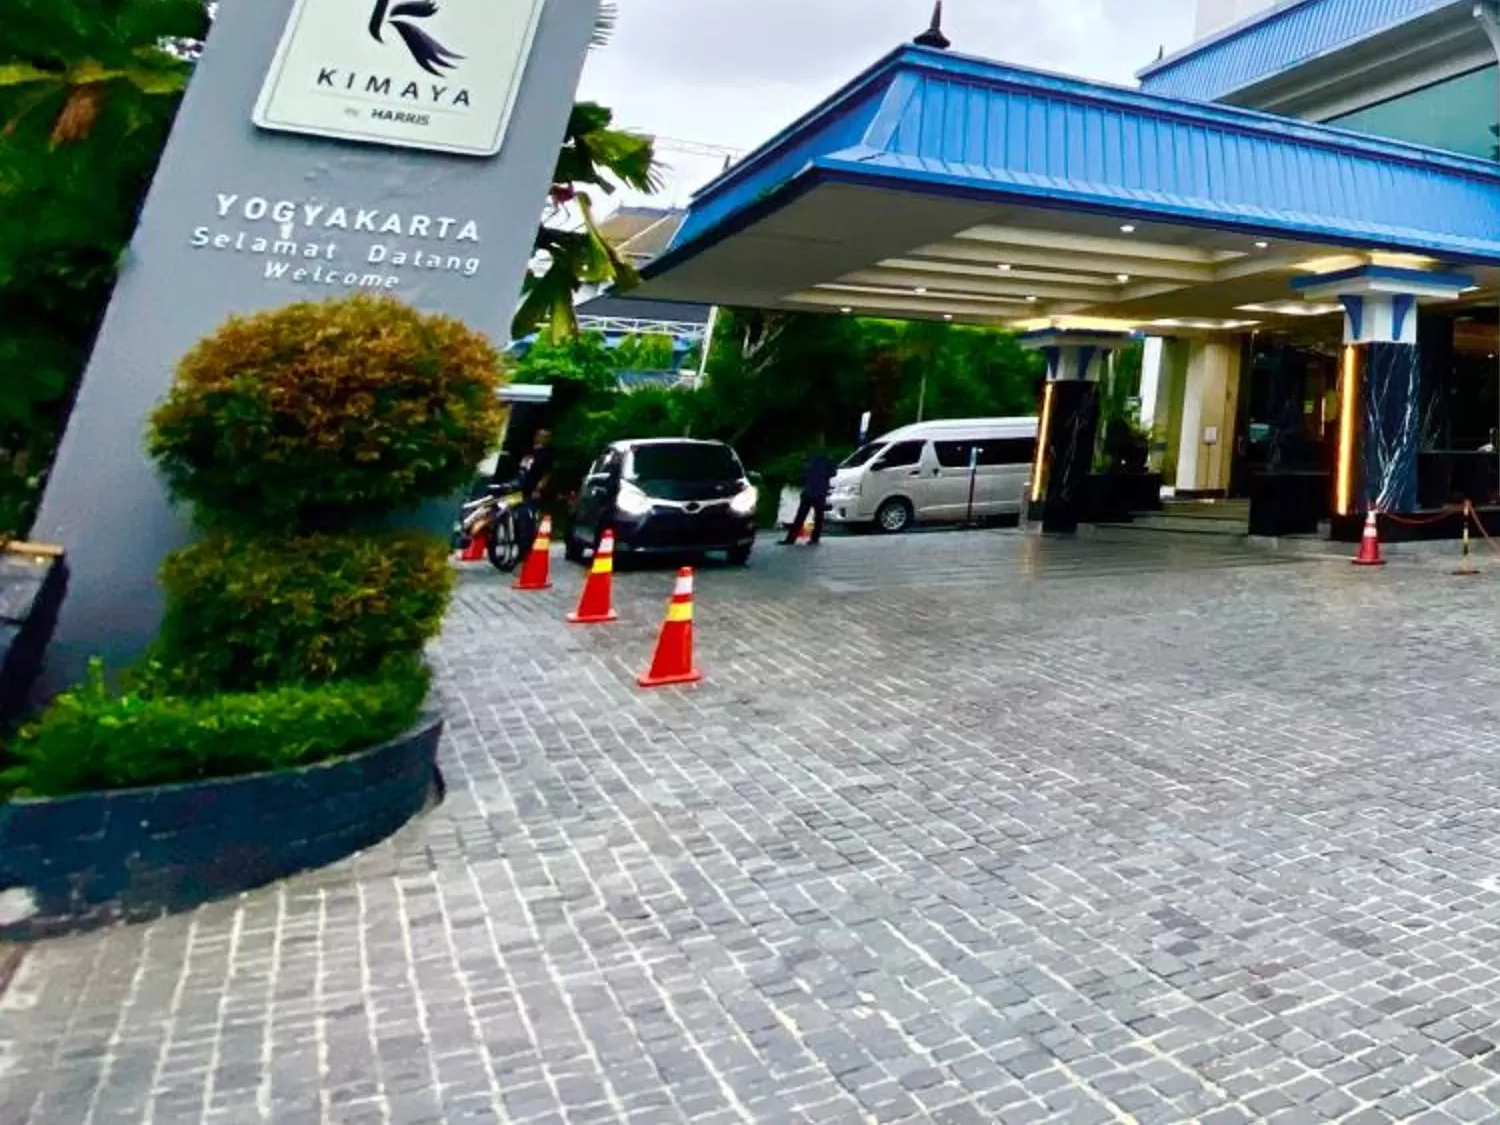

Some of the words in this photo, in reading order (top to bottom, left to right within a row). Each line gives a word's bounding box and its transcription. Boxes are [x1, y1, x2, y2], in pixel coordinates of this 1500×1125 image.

[317, 67, 470, 107] KIMAYA
[371, 108, 430, 125] HARRIS
[216, 194, 480, 241] YOGYAKARTA
[191, 226, 337, 260] Selamat
[367, 244, 480, 275] Datang
[263, 261, 400, 289] Welcome
